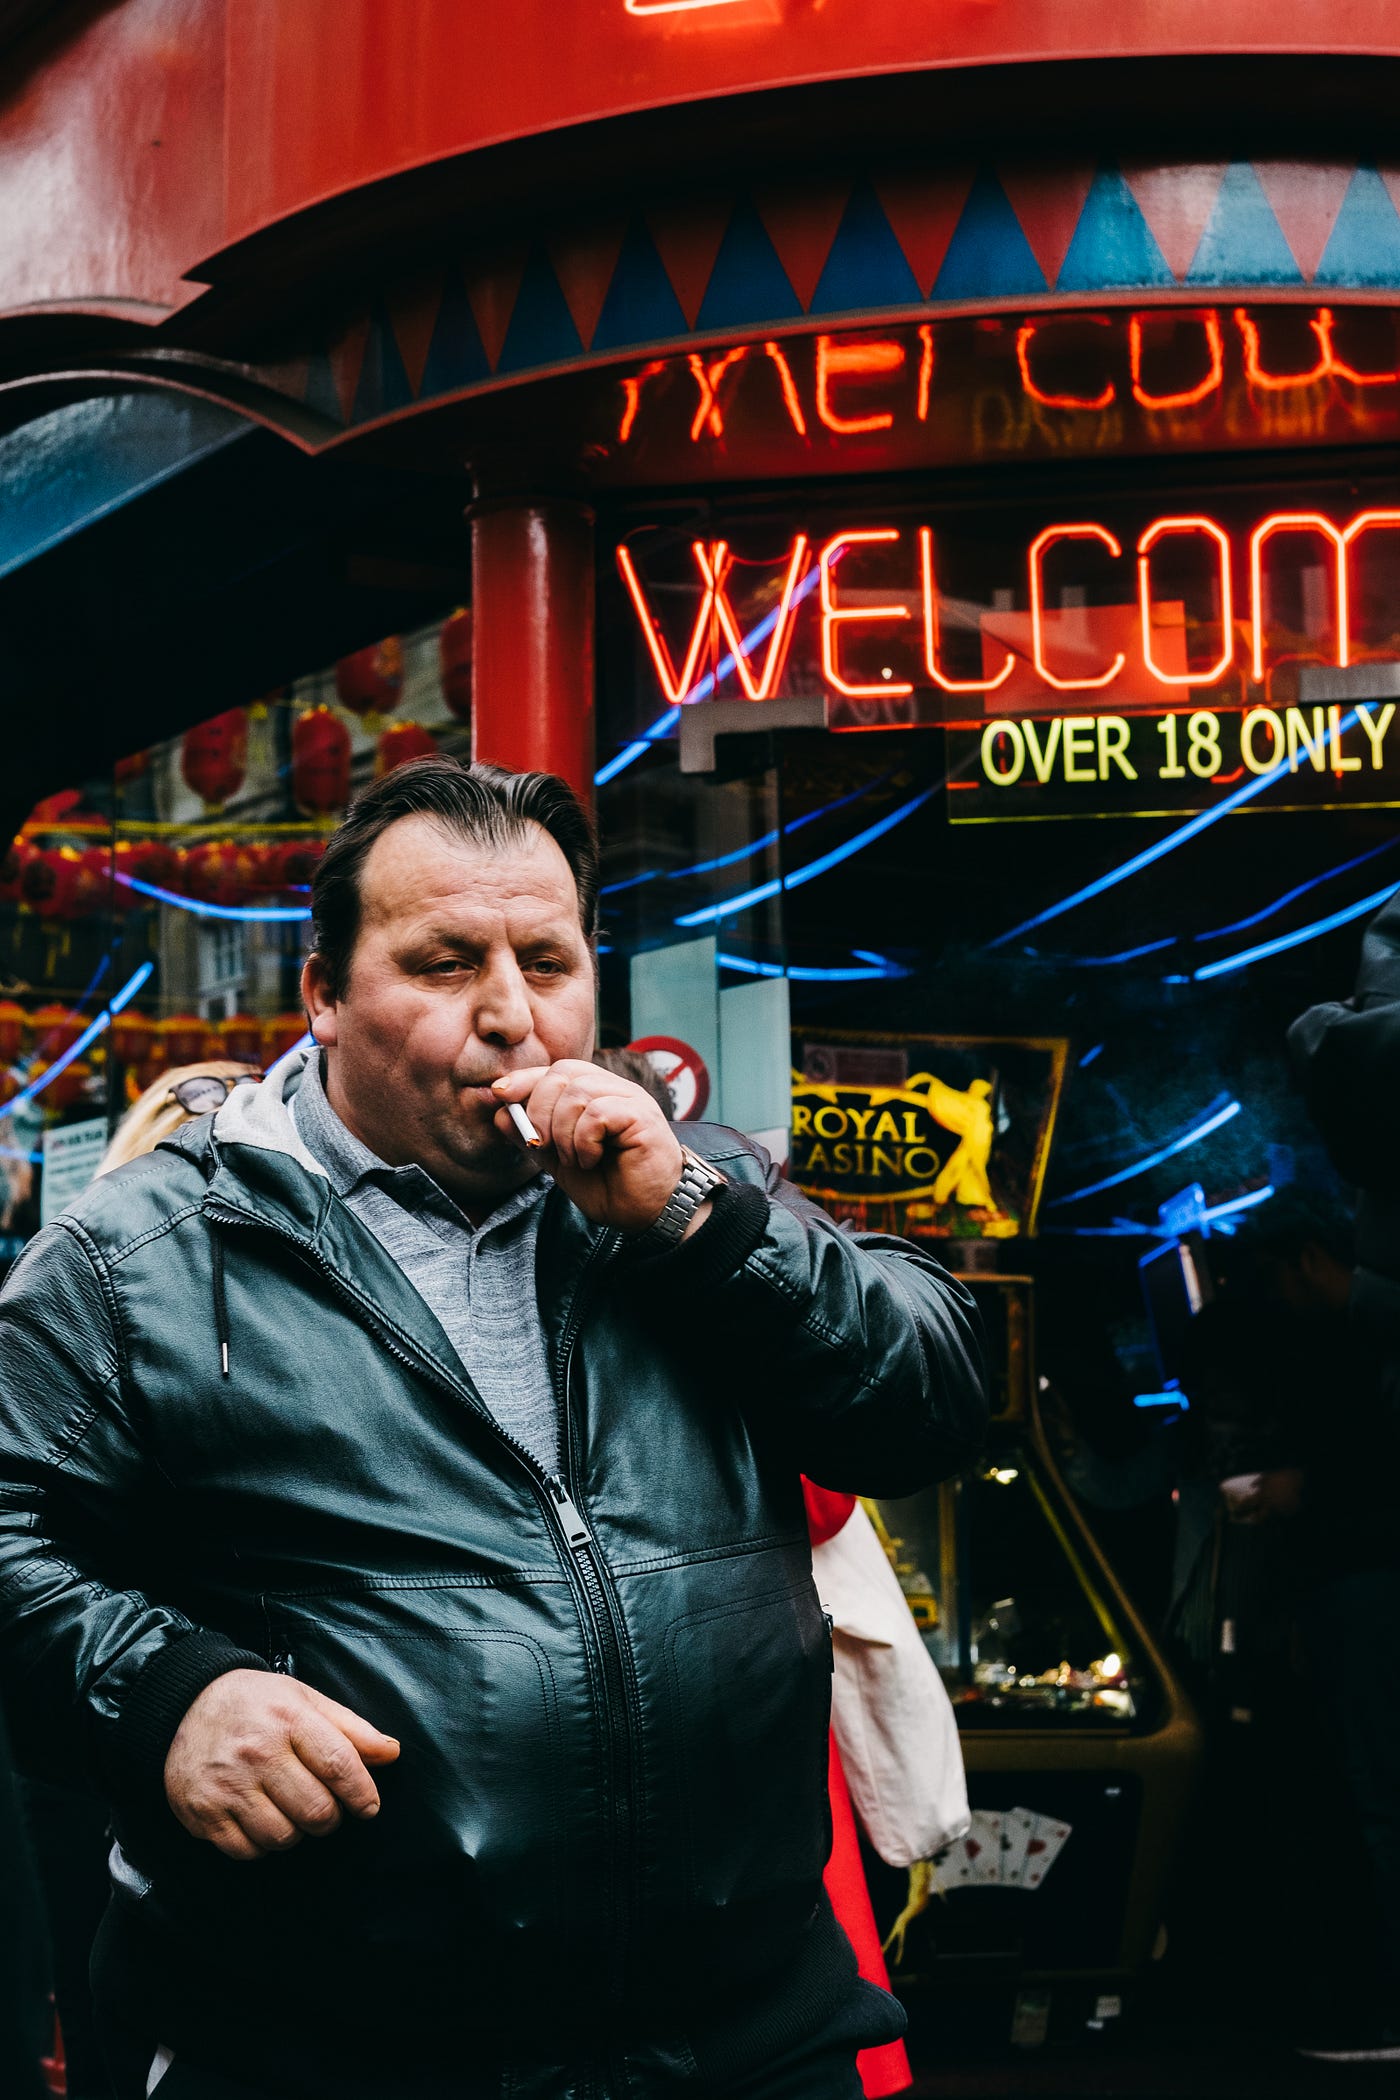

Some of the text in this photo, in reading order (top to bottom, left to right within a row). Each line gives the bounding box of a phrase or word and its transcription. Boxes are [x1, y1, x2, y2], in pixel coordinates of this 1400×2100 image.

[980, 704, 1396, 787] OVER 18 ONLY
[791, 1104, 927, 1144] ROYAL
[792, 1141, 941, 1180] ASINO
